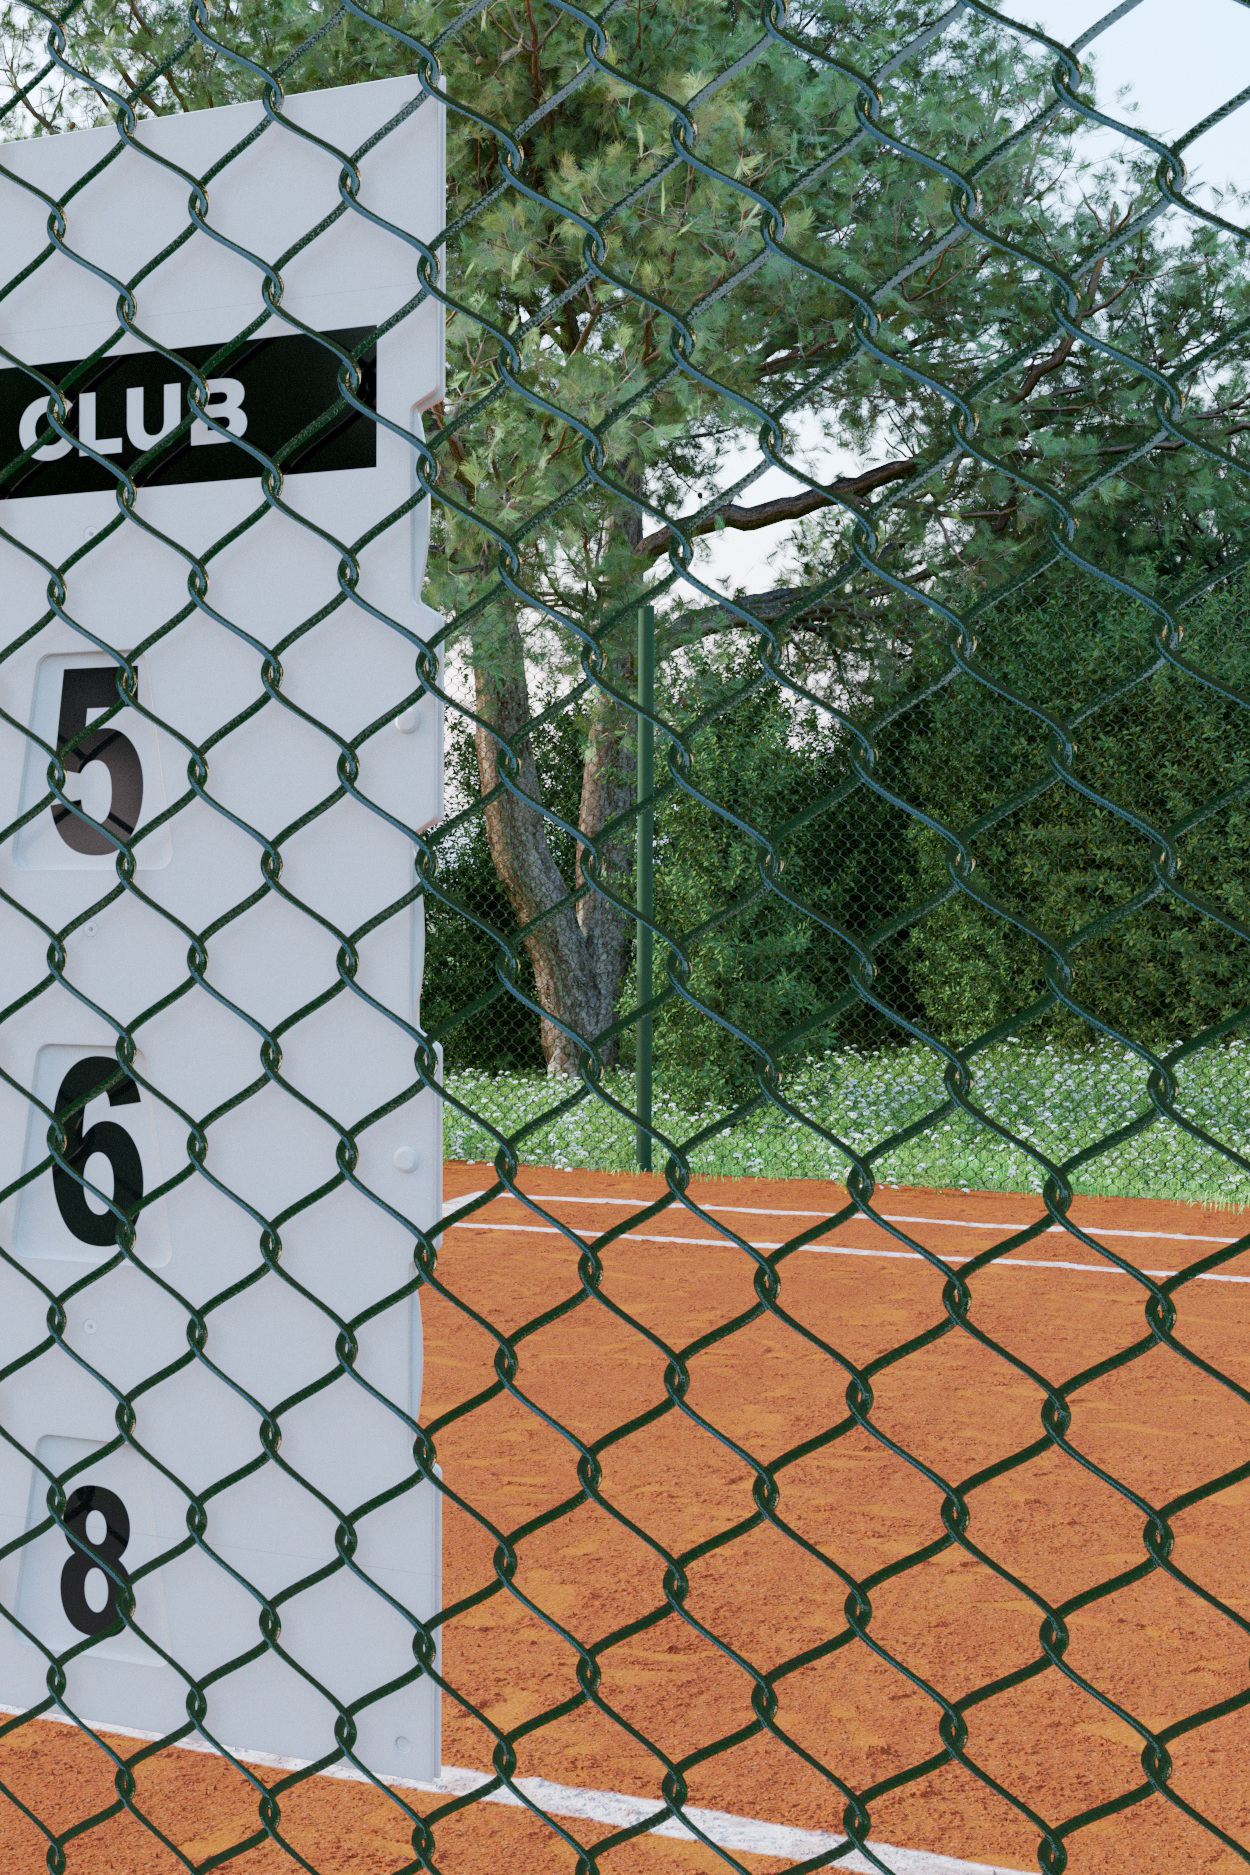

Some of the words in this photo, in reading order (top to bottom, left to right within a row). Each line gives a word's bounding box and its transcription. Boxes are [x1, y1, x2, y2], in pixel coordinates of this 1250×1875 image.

[18, 377, 249, 463] CLUB
[50, 665, 144, 856] 5
[50, 1055, 144, 1247] 6
[59, 1484, 133, 1638] 8
